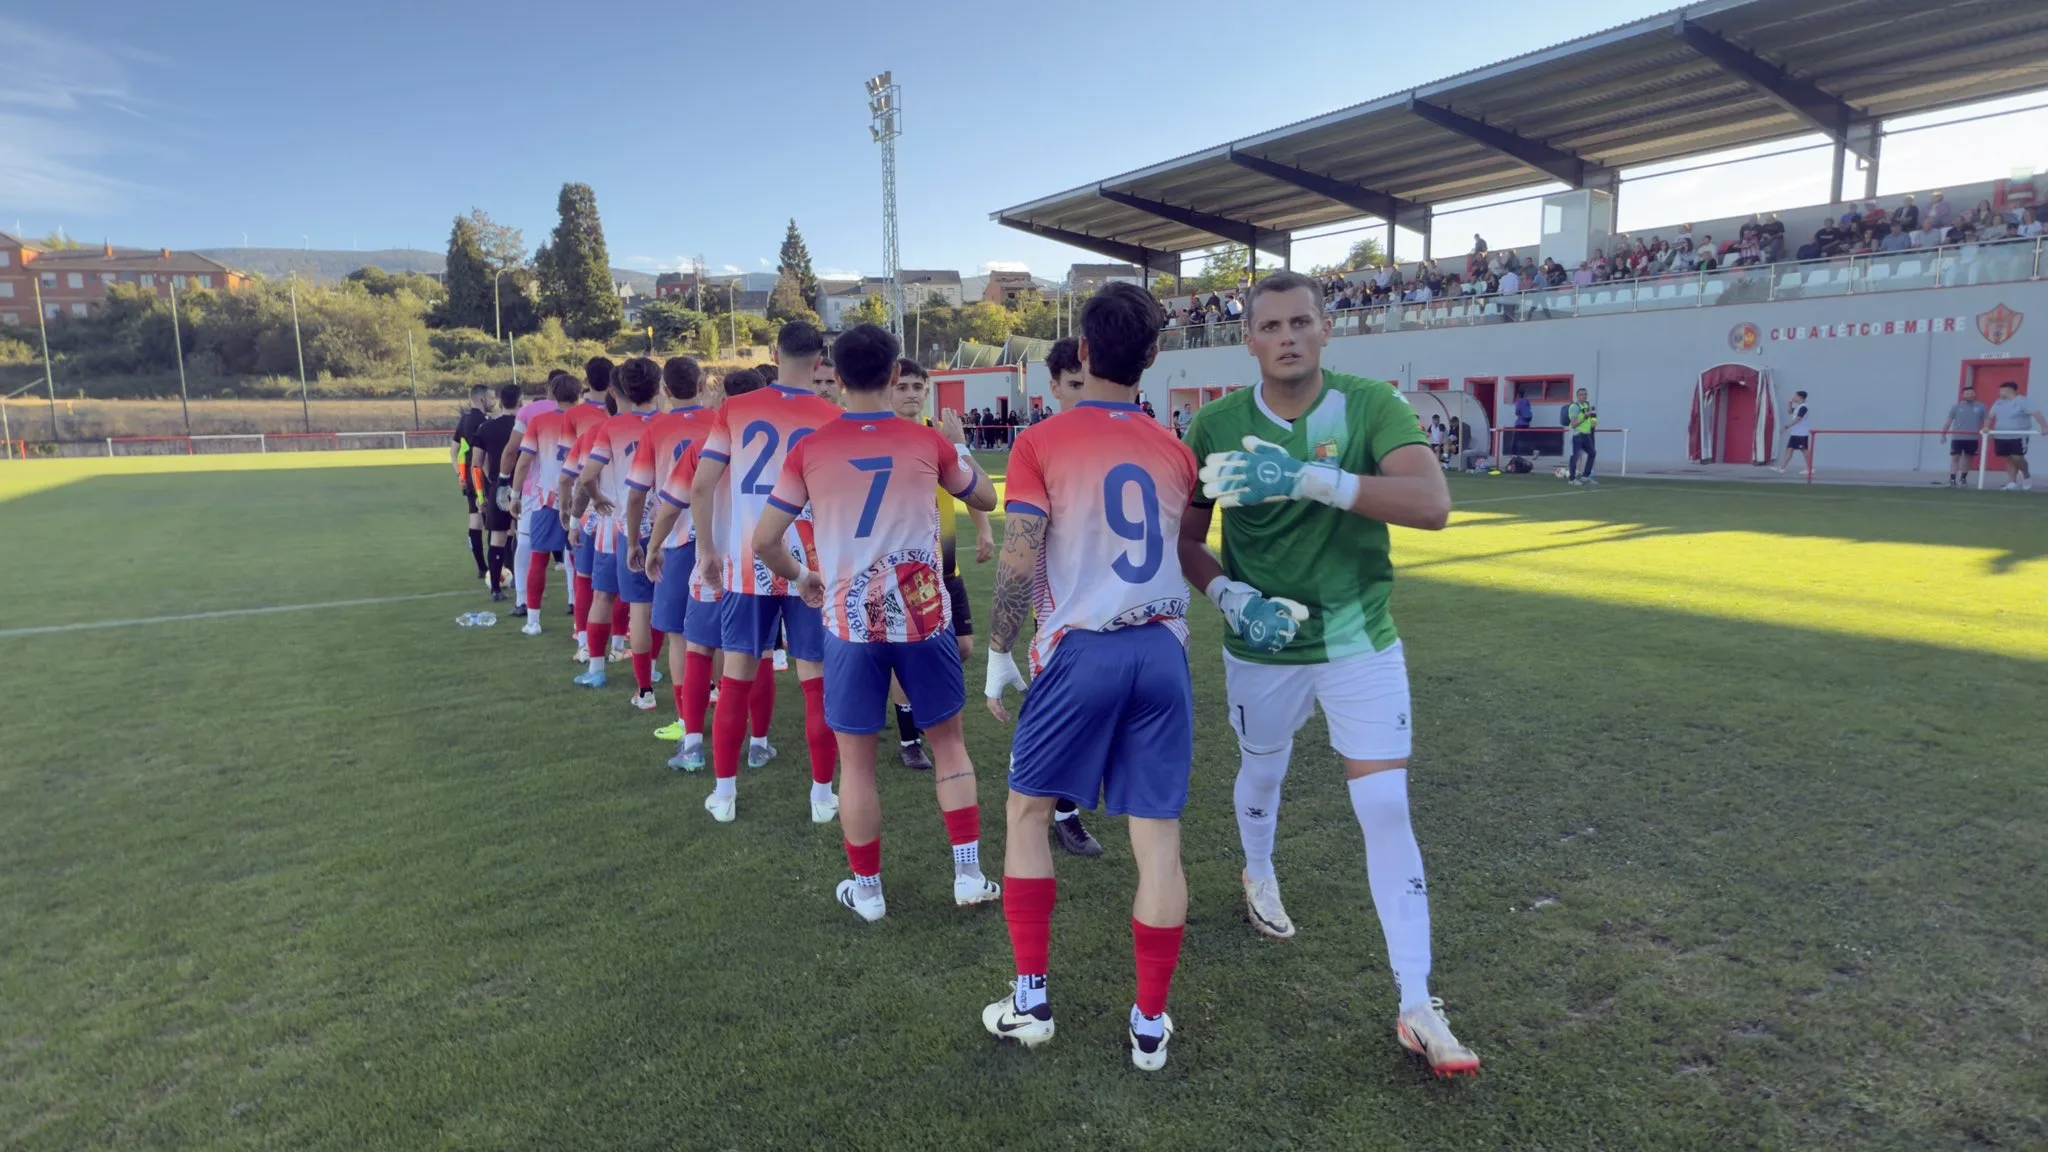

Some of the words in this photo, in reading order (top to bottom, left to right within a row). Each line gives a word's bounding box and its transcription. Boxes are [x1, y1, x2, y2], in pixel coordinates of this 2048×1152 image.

[1770, 327, 1806, 341] CLUB
[1884, 316, 1967, 336] BEMBIBRE
[741, 420, 816, 494] 2
[848, 455, 893, 538] 7
[1103, 463, 1164, 584] 9
[1236, 703, 1247, 736] 1
